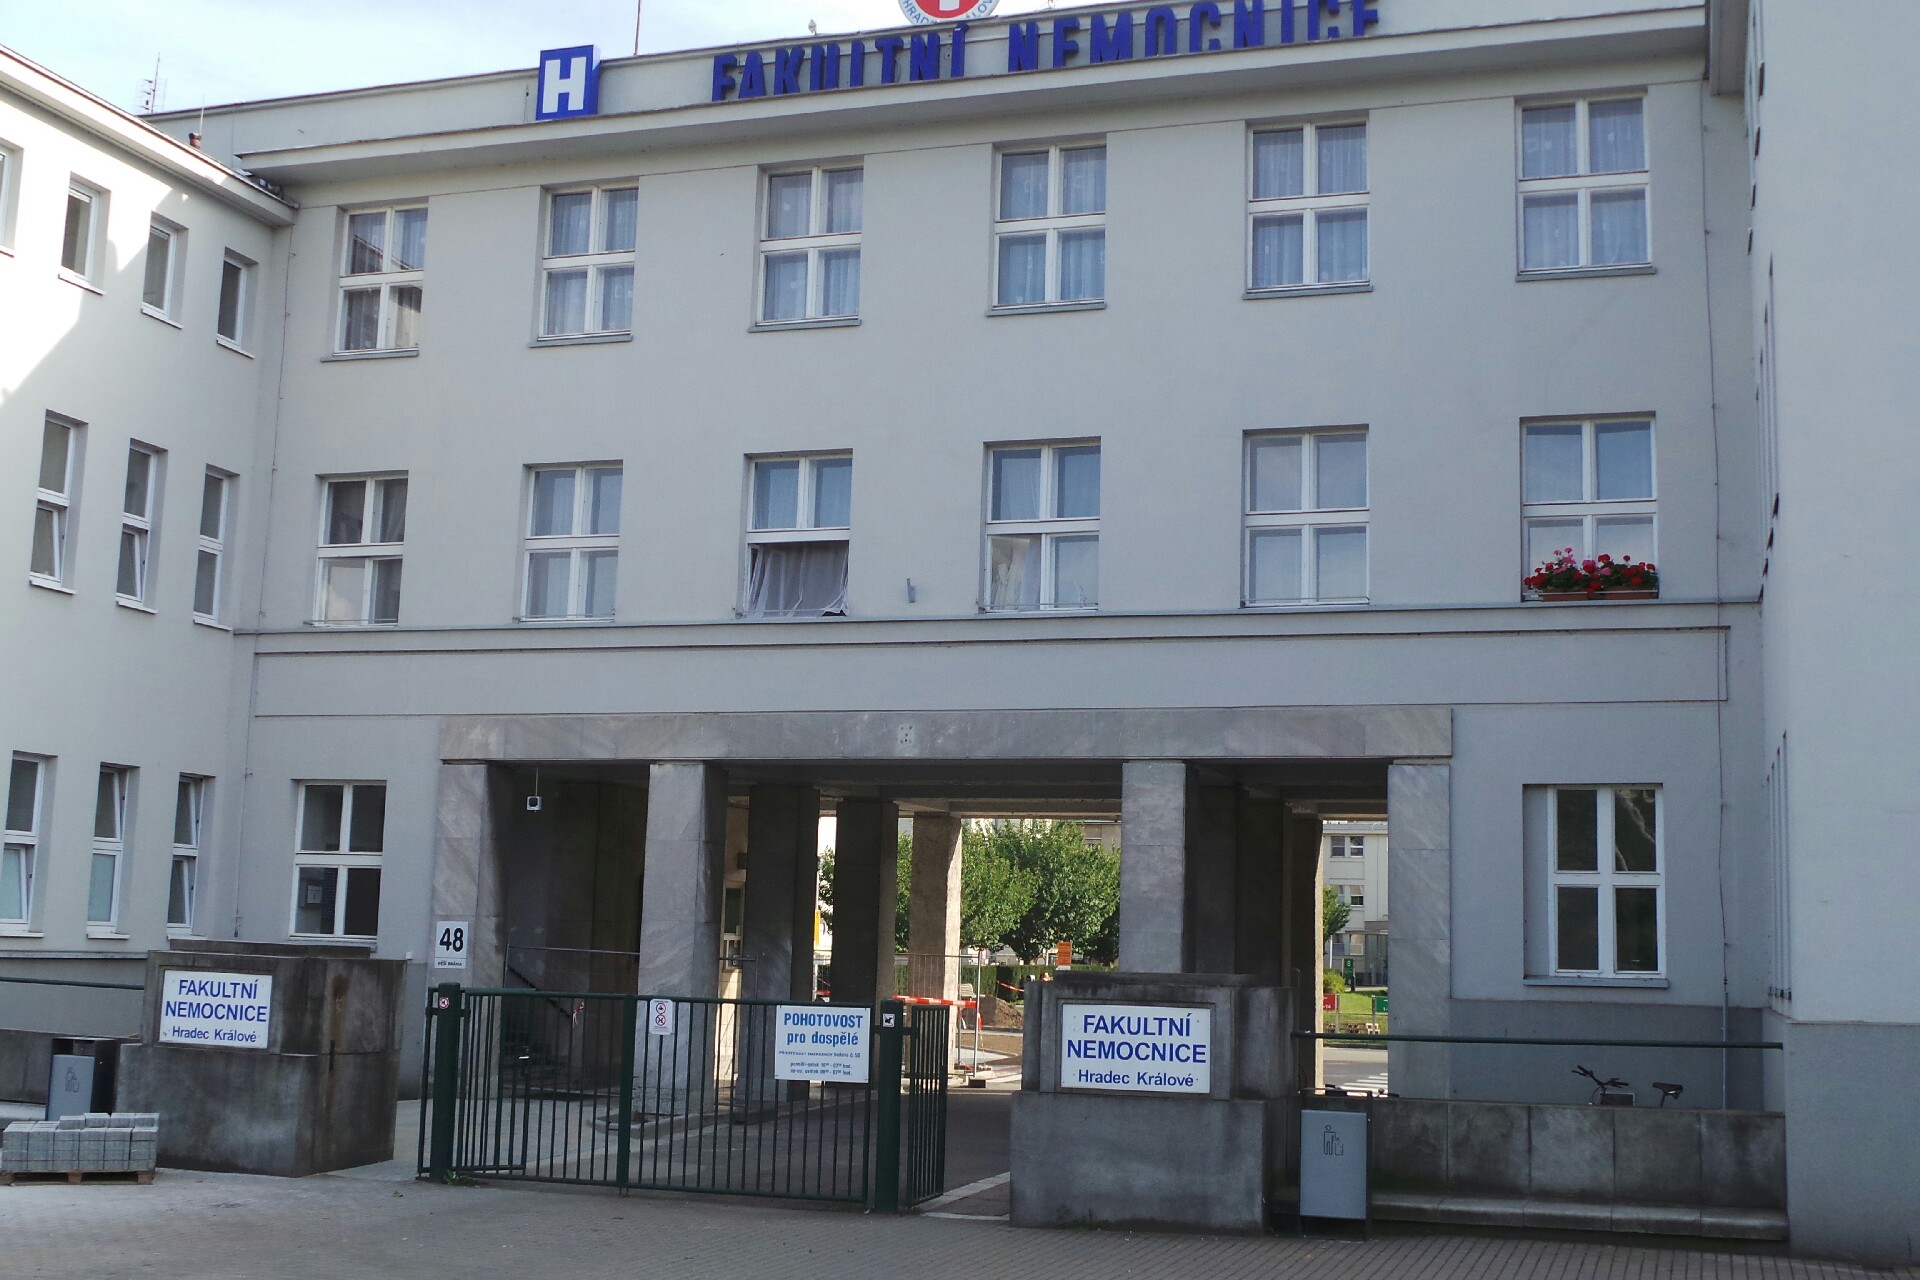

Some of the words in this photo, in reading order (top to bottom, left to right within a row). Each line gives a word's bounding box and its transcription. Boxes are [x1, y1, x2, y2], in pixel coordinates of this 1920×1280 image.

[542, 56, 587, 114] H
[439, 927, 464, 952] 48
[178, 979, 259, 999] FAKULTNÍ
[165, 1000, 268, 1022] NEMOCNICE
[784, 1012, 864, 1028] POHOTOVOST
[172, 1025, 210, 1040] Hradec
[214, 1028, 257, 1043] Králové
[1083, 1013, 1192, 1037] FAKULTNÍ
[787, 1033, 806, 1045] pro
[811, 1031, 859, 1047] dospělé
[1067, 1039, 1207, 1063] NEMOCNICE
[1078, 1069, 1130, 1084] Hradec
[1137, 1071, 1194, 1087] Králové
